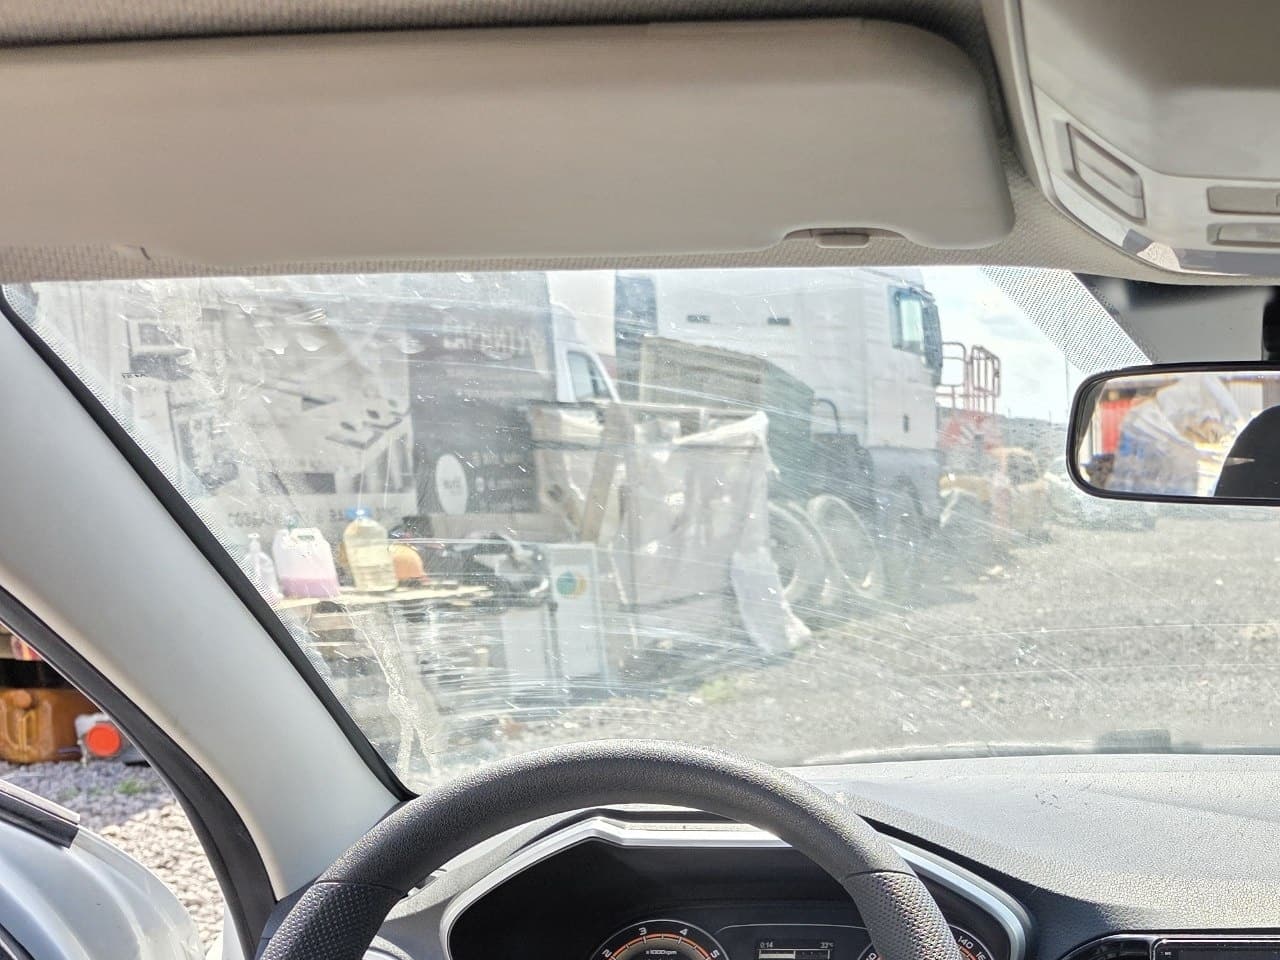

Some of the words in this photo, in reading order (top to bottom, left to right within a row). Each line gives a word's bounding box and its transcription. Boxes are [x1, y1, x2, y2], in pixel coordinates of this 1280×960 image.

[638, 927, 648, 936] 3
[679, 928, 689, 936] 4
[957, 936, 974, 949] 140
[601, 949, 612, 958] 2
[710, 949, 720, 959] 5
